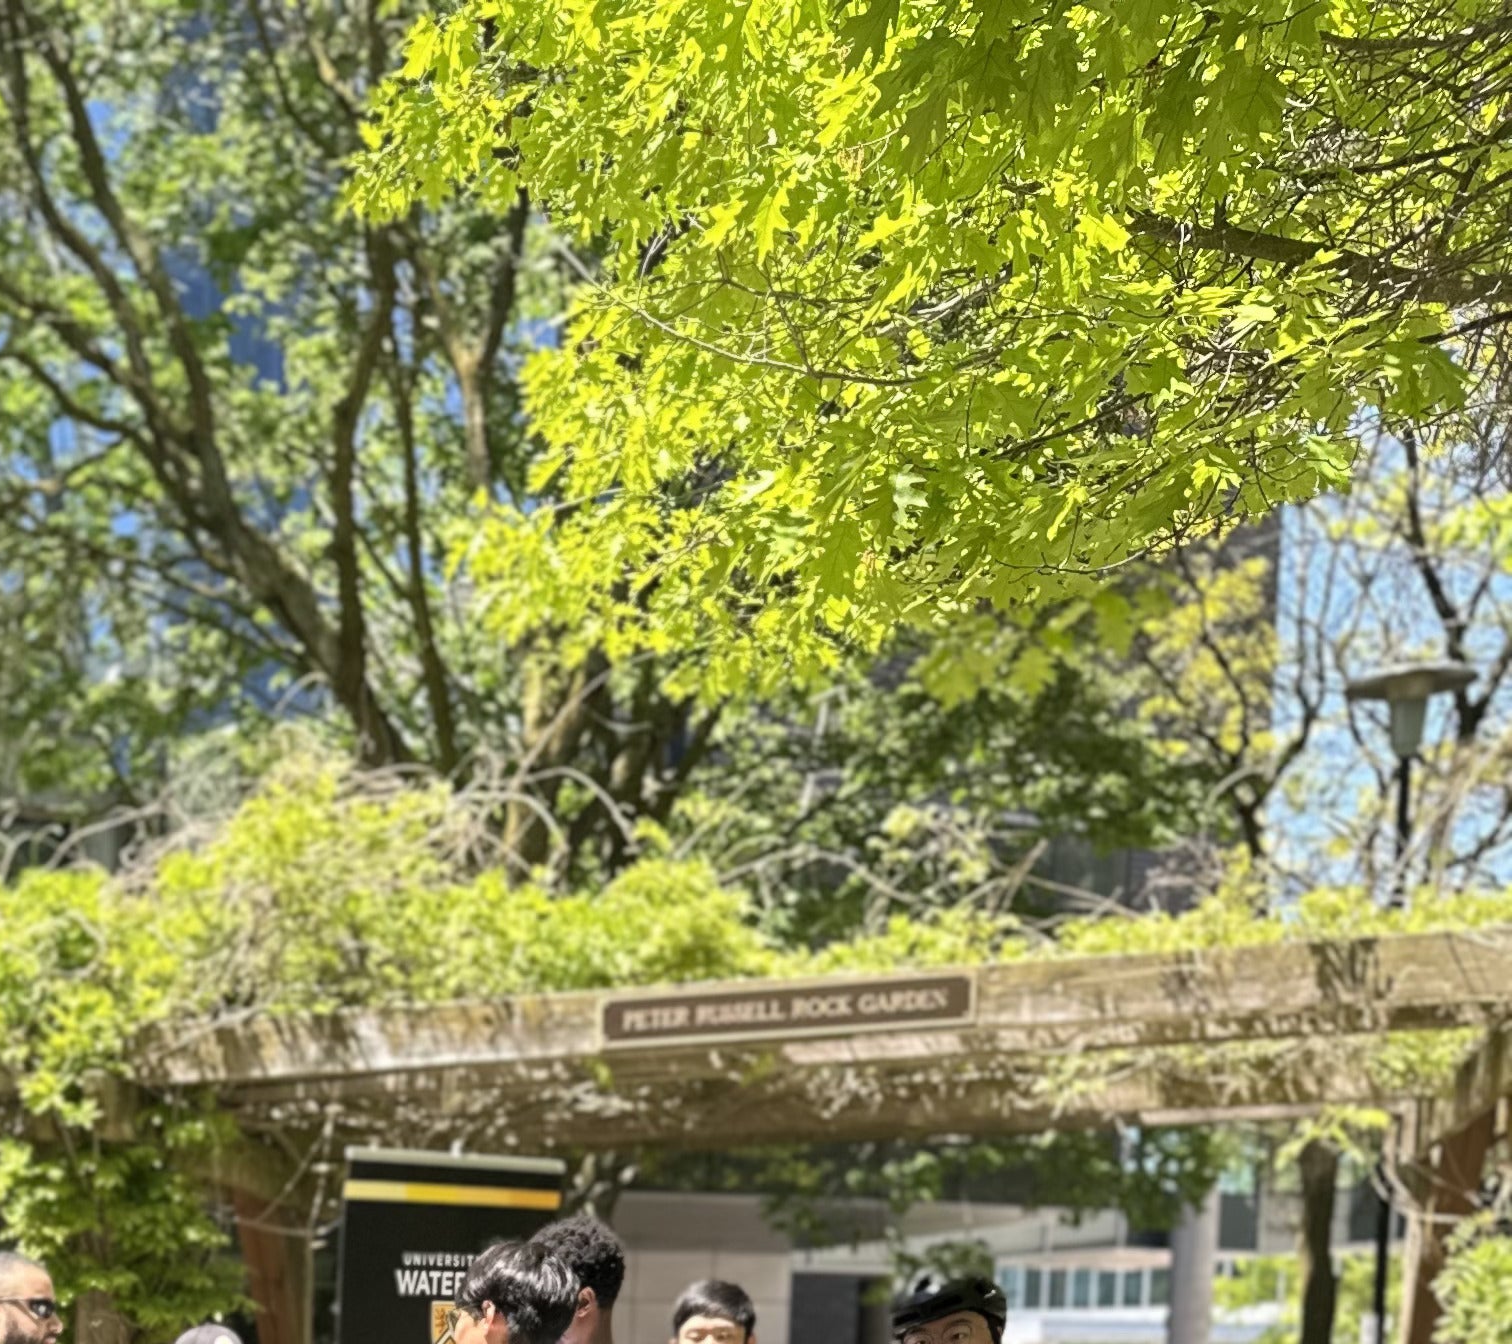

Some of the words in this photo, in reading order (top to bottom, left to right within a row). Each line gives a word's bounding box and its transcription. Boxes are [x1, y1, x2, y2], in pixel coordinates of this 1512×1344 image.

[792, 994, 854, 1019] ROCK
[857, 988, 948, 1014] GARDEN
[402, 1252, 479, 1267] UNIVERSIT
